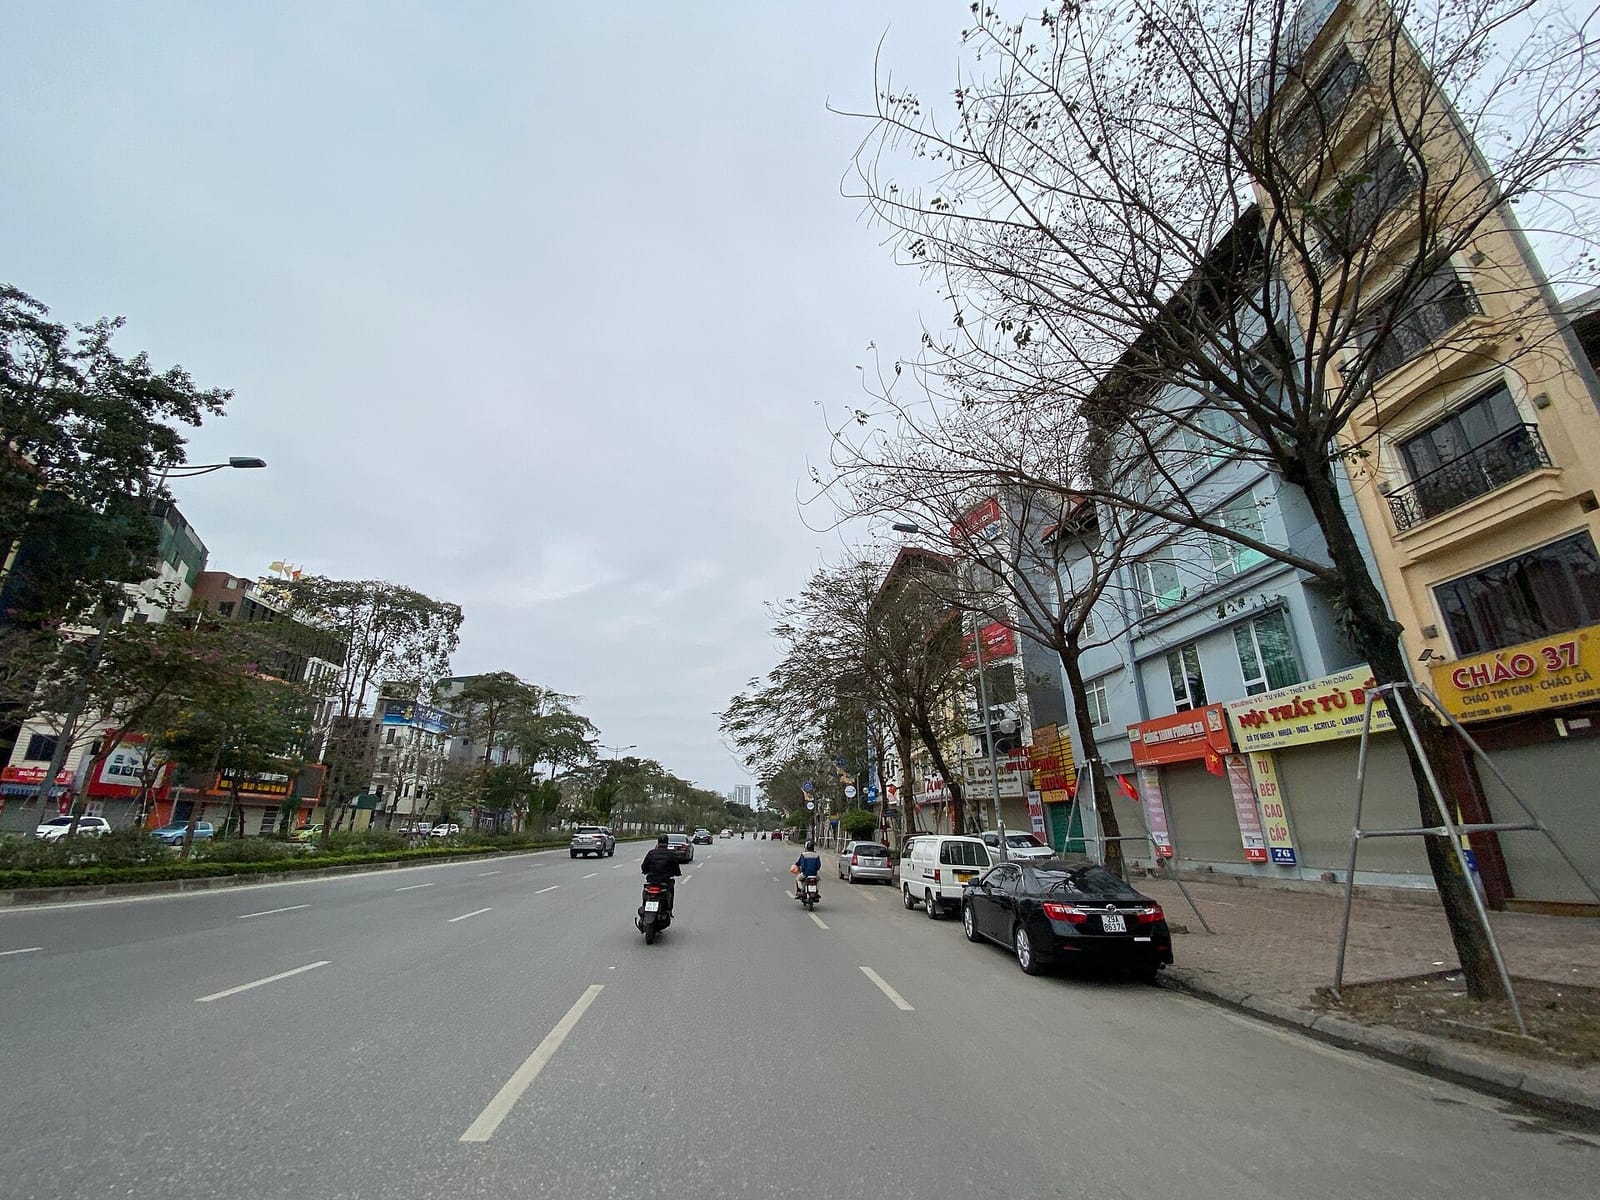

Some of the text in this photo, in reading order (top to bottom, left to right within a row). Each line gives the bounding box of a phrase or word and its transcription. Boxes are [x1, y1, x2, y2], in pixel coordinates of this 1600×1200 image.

[1452, 641, 1580, 690] CHÁO 37
[1491, 688, 1510, 700] TIM
[1238, 708, 1269, 729] NỘI
[1268, 695, 1317, 722] THẤT
[1317, 687, 1348, 712] TỦ
[1313, 719, 1337, 731] ACRYLIC
[1260, 778, 1277, 797] BẾP
[1264, 804, 1283, 818] CAO
[1269, 822, 1288, 841] CẤP
[1275, 849, 1291, 858] 76
